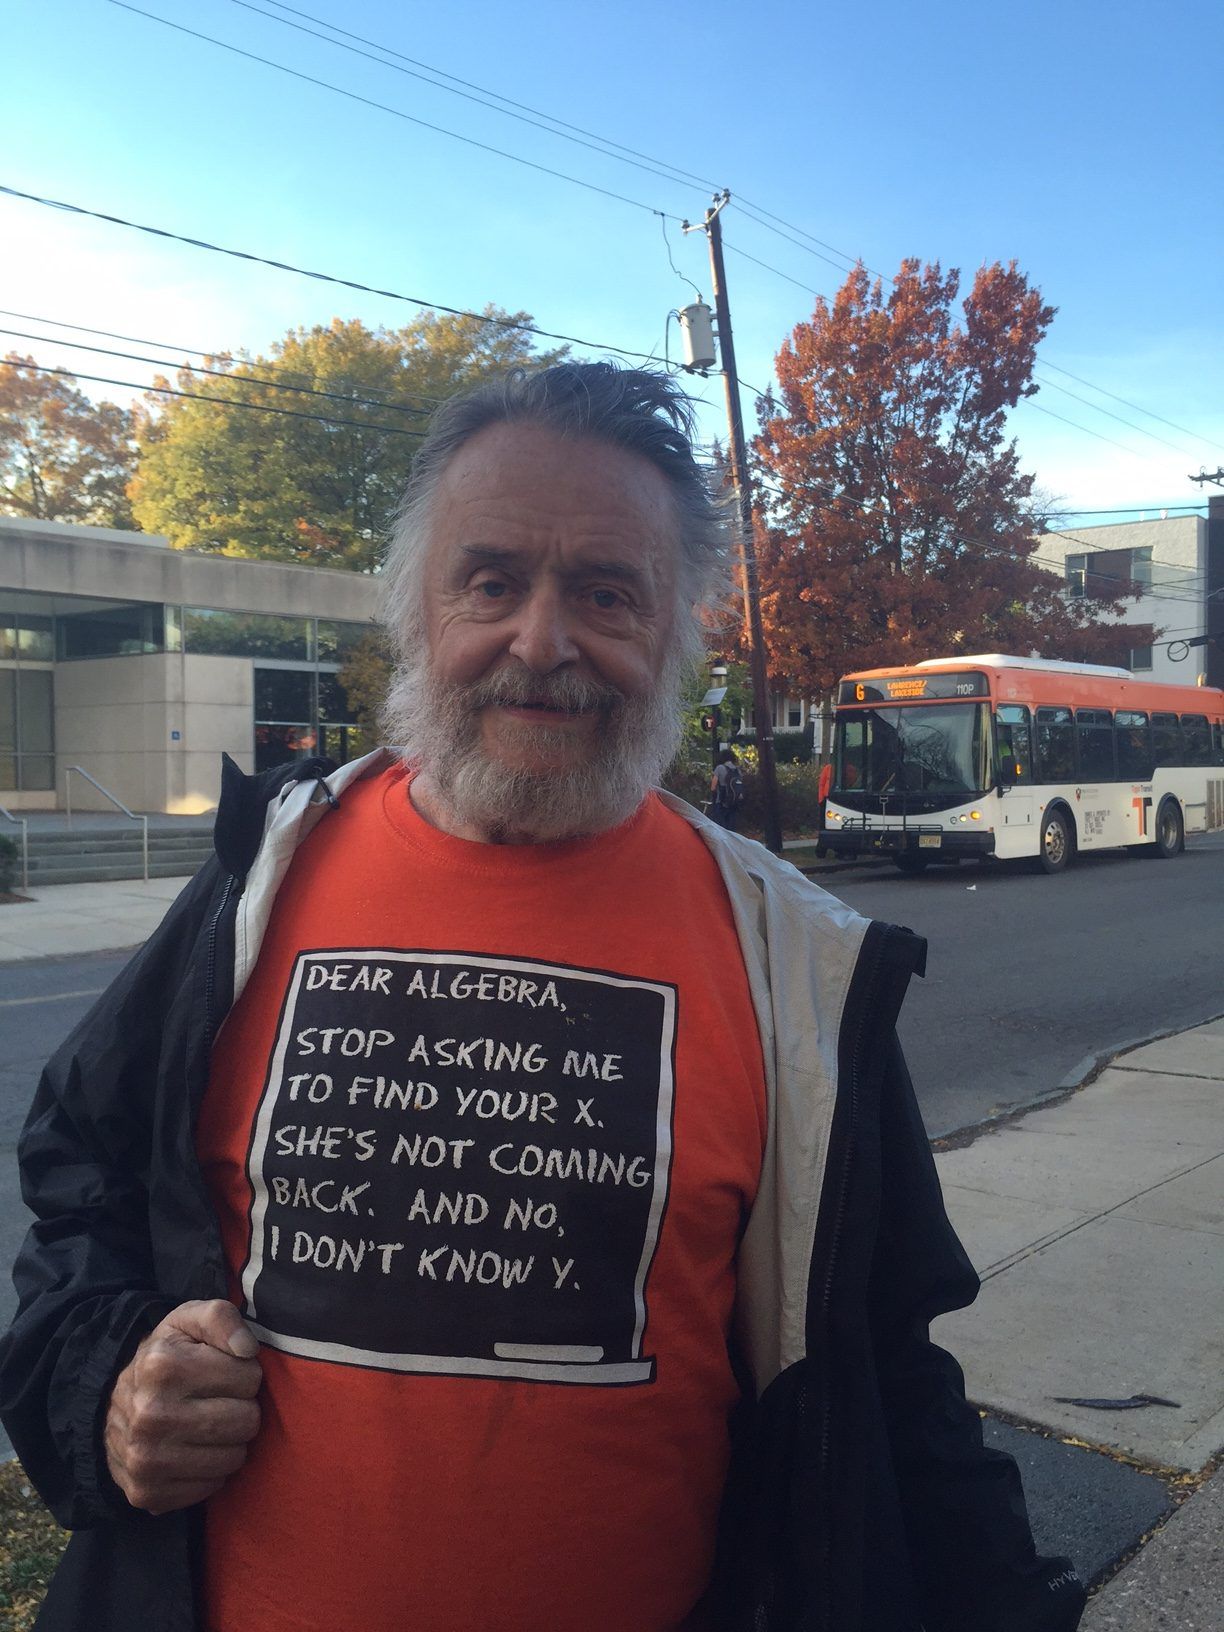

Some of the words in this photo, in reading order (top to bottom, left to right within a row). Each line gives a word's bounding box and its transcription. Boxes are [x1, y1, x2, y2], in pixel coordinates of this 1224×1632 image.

[306, 965, 393, 995] DEAR
[406, 969, 568, 1012] ALGEBRA,
[297, 1027, 395, 1058] STOP
[408, 1034, 549, 1073] ASKING
[562, 1050, 624, 1082] ME
[288, 1072, 333, 1104] TO
[348, 1076, 439, 1111] FIND
[456, 1086, 558, 1124] YOUR
[573, 1098, 604, 1128] X.
[274, 1124, 376, 1162] SHE'S
[391, 1134, 475, 1169] NOT
[489, 1142, 652, 1188] COMING
[272, 1176, 375, 1217] BACK.
[408, 1188, 489, 1226] AND
[503, 1197, 565, 1237] NO,
[271, 1226, 280, 1260] I
[292, 1231, 404, 1274] DON'T
[417, 1243, 535, 1289] KNOW
[552, 1256, 581, 1291] Y.
